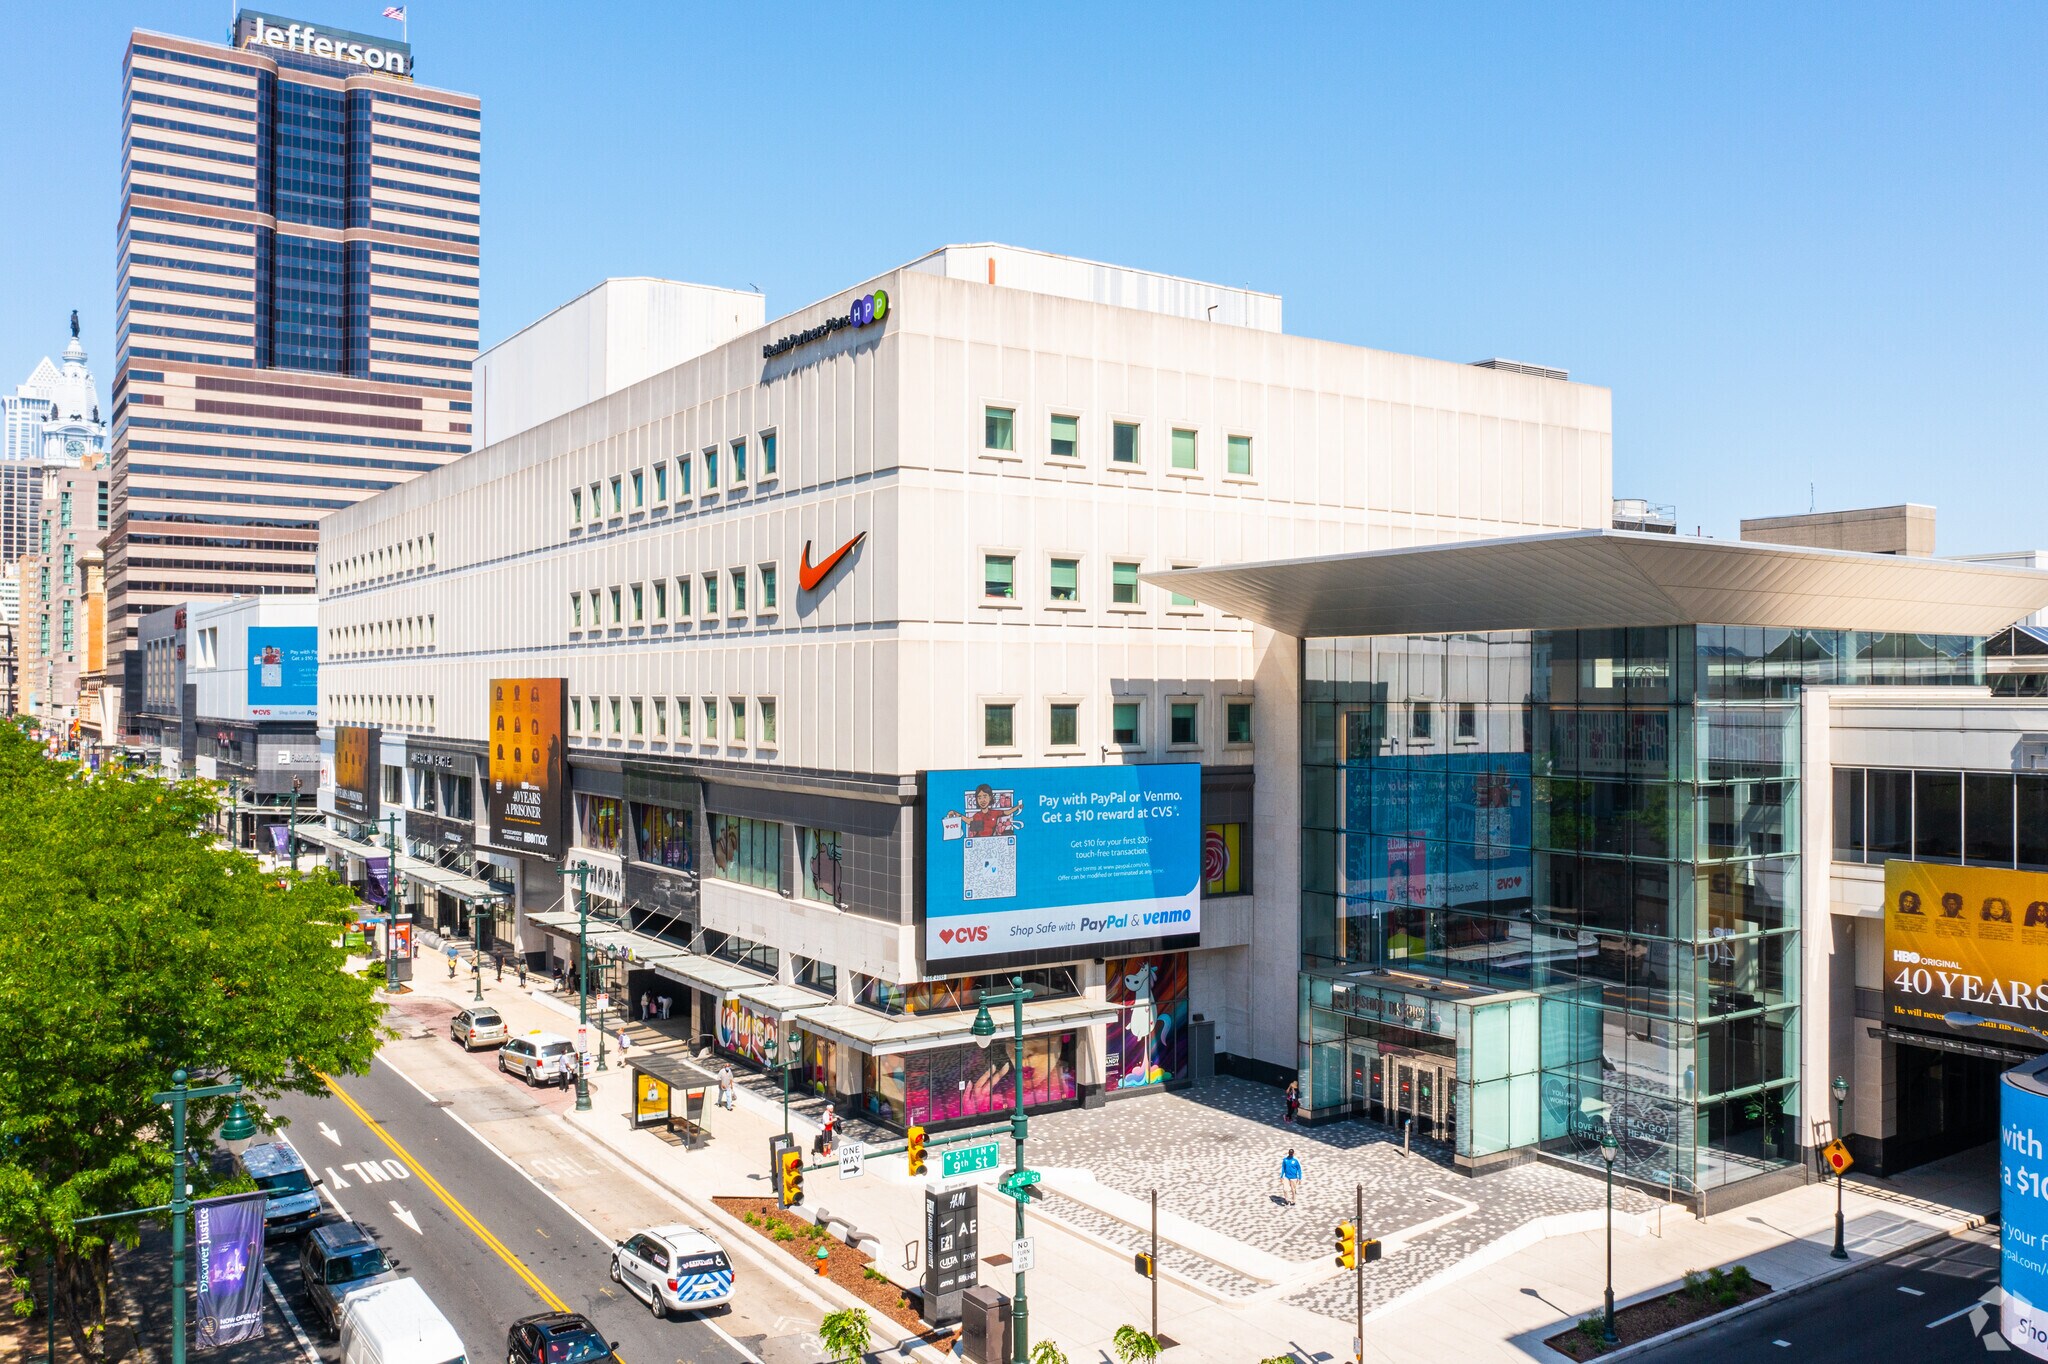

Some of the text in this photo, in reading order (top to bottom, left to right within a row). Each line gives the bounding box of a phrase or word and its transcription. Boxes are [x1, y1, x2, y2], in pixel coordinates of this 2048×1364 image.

[250, 17, 404, 74] Jefferson
[512, 791, 541, 805] 40 YEARS
[1039, 790, 1183, 810] Pay with PayPal or Venmo.
[505, 803, 541, 819] A PRISONER
[1041, 811, 1063, 824] Get
[1065, 813, 1072, 823] a
[1074, 809, 1095, 823] $10
[1097, 807, 1135, 821] reward
[1137, 807, 1149, 819] at
[1070, 839, 1083, 849] Get
[1083, 838, 1096, 849] $10
[1096, 837, 1106, 847] for
[1106, 838, 1121, 848] your
[1122, 836, 1137, 846] first
[1075, 846, 1149, 860] touch-free transaction.
[570, 860, 621, 891] SEHORA
[1074, 865, 1083, 873] See
[1083, 864, 1098, 872] terms
[1086, 871, 1108, 880] modified
[1010, 908, 1192, 938] Shop Safe with PayPal & venmo
[1893, 949, 1963, 970] HBO ORIGINAL
[1893, 966, 2048, 1013] 40 YEARS
[1894, 1005, 1906, 1015] He
[1906, 1008, 1922, 1018] will
[1549, 1097, 1572, 1106] WORTH
[1551, 1089, 1577, 1100] YOU ARE
[1573, 1120, 1606, 1134] LOVE UR
[1648, 1123, 1668, 1137] GOT
[1577, 1128, 1601, 1142] STYLE
[1627, 1128, 1658, 1144] HEART
[2002, 1123, 2043, 1160] with
[843, 1145, 860, 1156] ONE
[843, 1155, 860, 1165] WAY
[953, 1156, 988, 1173] 9th St
[325, 1159, 410, 1189] ONLY
[1032, 1175, 1040, 1183] St
[2004, 1165, 2012, 1187] a
[950, 1191, 967, 1209] H&M
[1003, 1185, 1030, 1204] Market St
[280, 1199, 313, 1210] LOCKSMITH
[958, 1219, 977, 1238] AE
[2008, 1224, 2037, 1247] your
[199, 1207, 211, 1293] Discover Justice
[940, 1234, 953, 1252] F21
[1017, 1241, 1029, 1249] NO
[941, 1255, 958, 1267] ULTA
[963, 1251, 976, 1262] DSW
[1018, 1262, 1029, 1270] RED
[219, 1317, 236, 1325] NOW
[235, 1313, 252, 1322] OPEN
[2018, 1318, 2048, 1346] Sho
